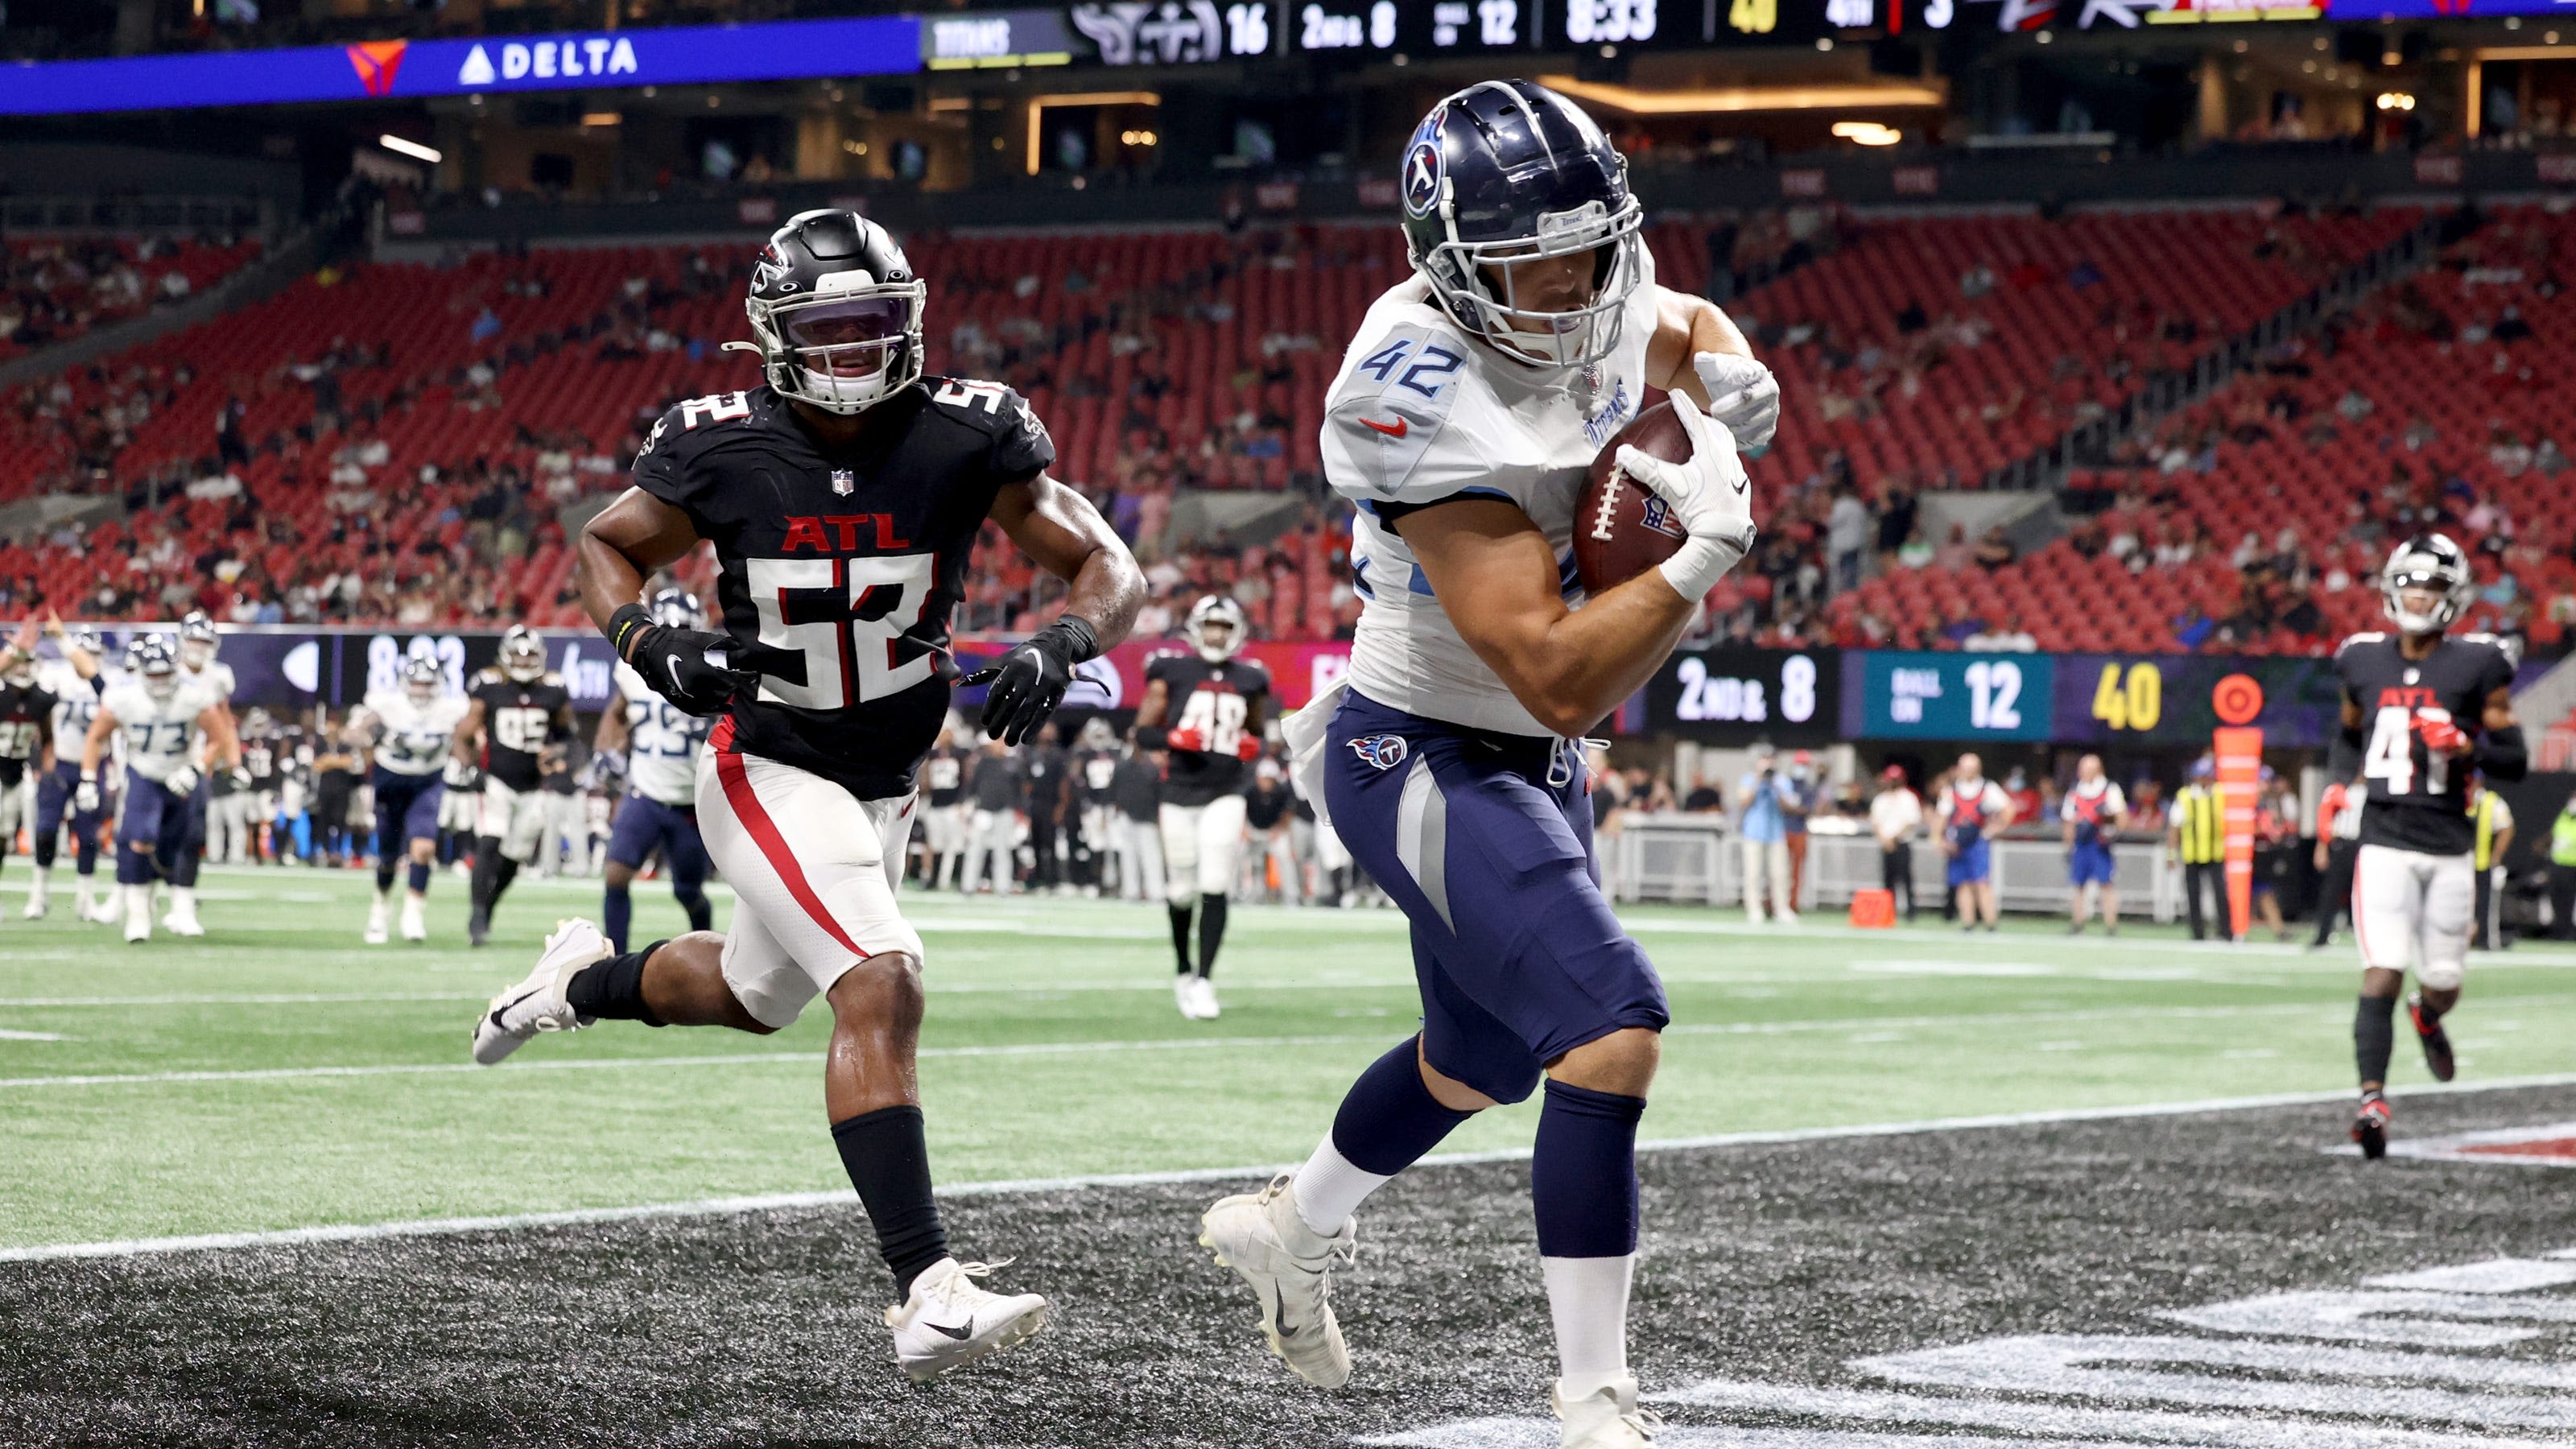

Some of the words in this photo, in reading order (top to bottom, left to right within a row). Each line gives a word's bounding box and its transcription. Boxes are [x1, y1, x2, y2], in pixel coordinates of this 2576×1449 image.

[1226, 2, 1269, 55] 16
[1370, 1, 1397, 48] 8
[1478, 0, 1517, 45] 12
[1566, 0, 1657, 43] 8:33
[502, 37, 638, 79] DELTA
[1359, 338, 1468, 401] 42
[781, 513, 910, 551] ATL
[745, 552, 940, 710] 52
[1780, 654, 1817, 723] 8
[1964, 660, 2023, 729] 12
[2091, 662, 2162, 732] 40
[2377, 687, 2444, 709] ATL
[130, 720, 188, 754] 73
